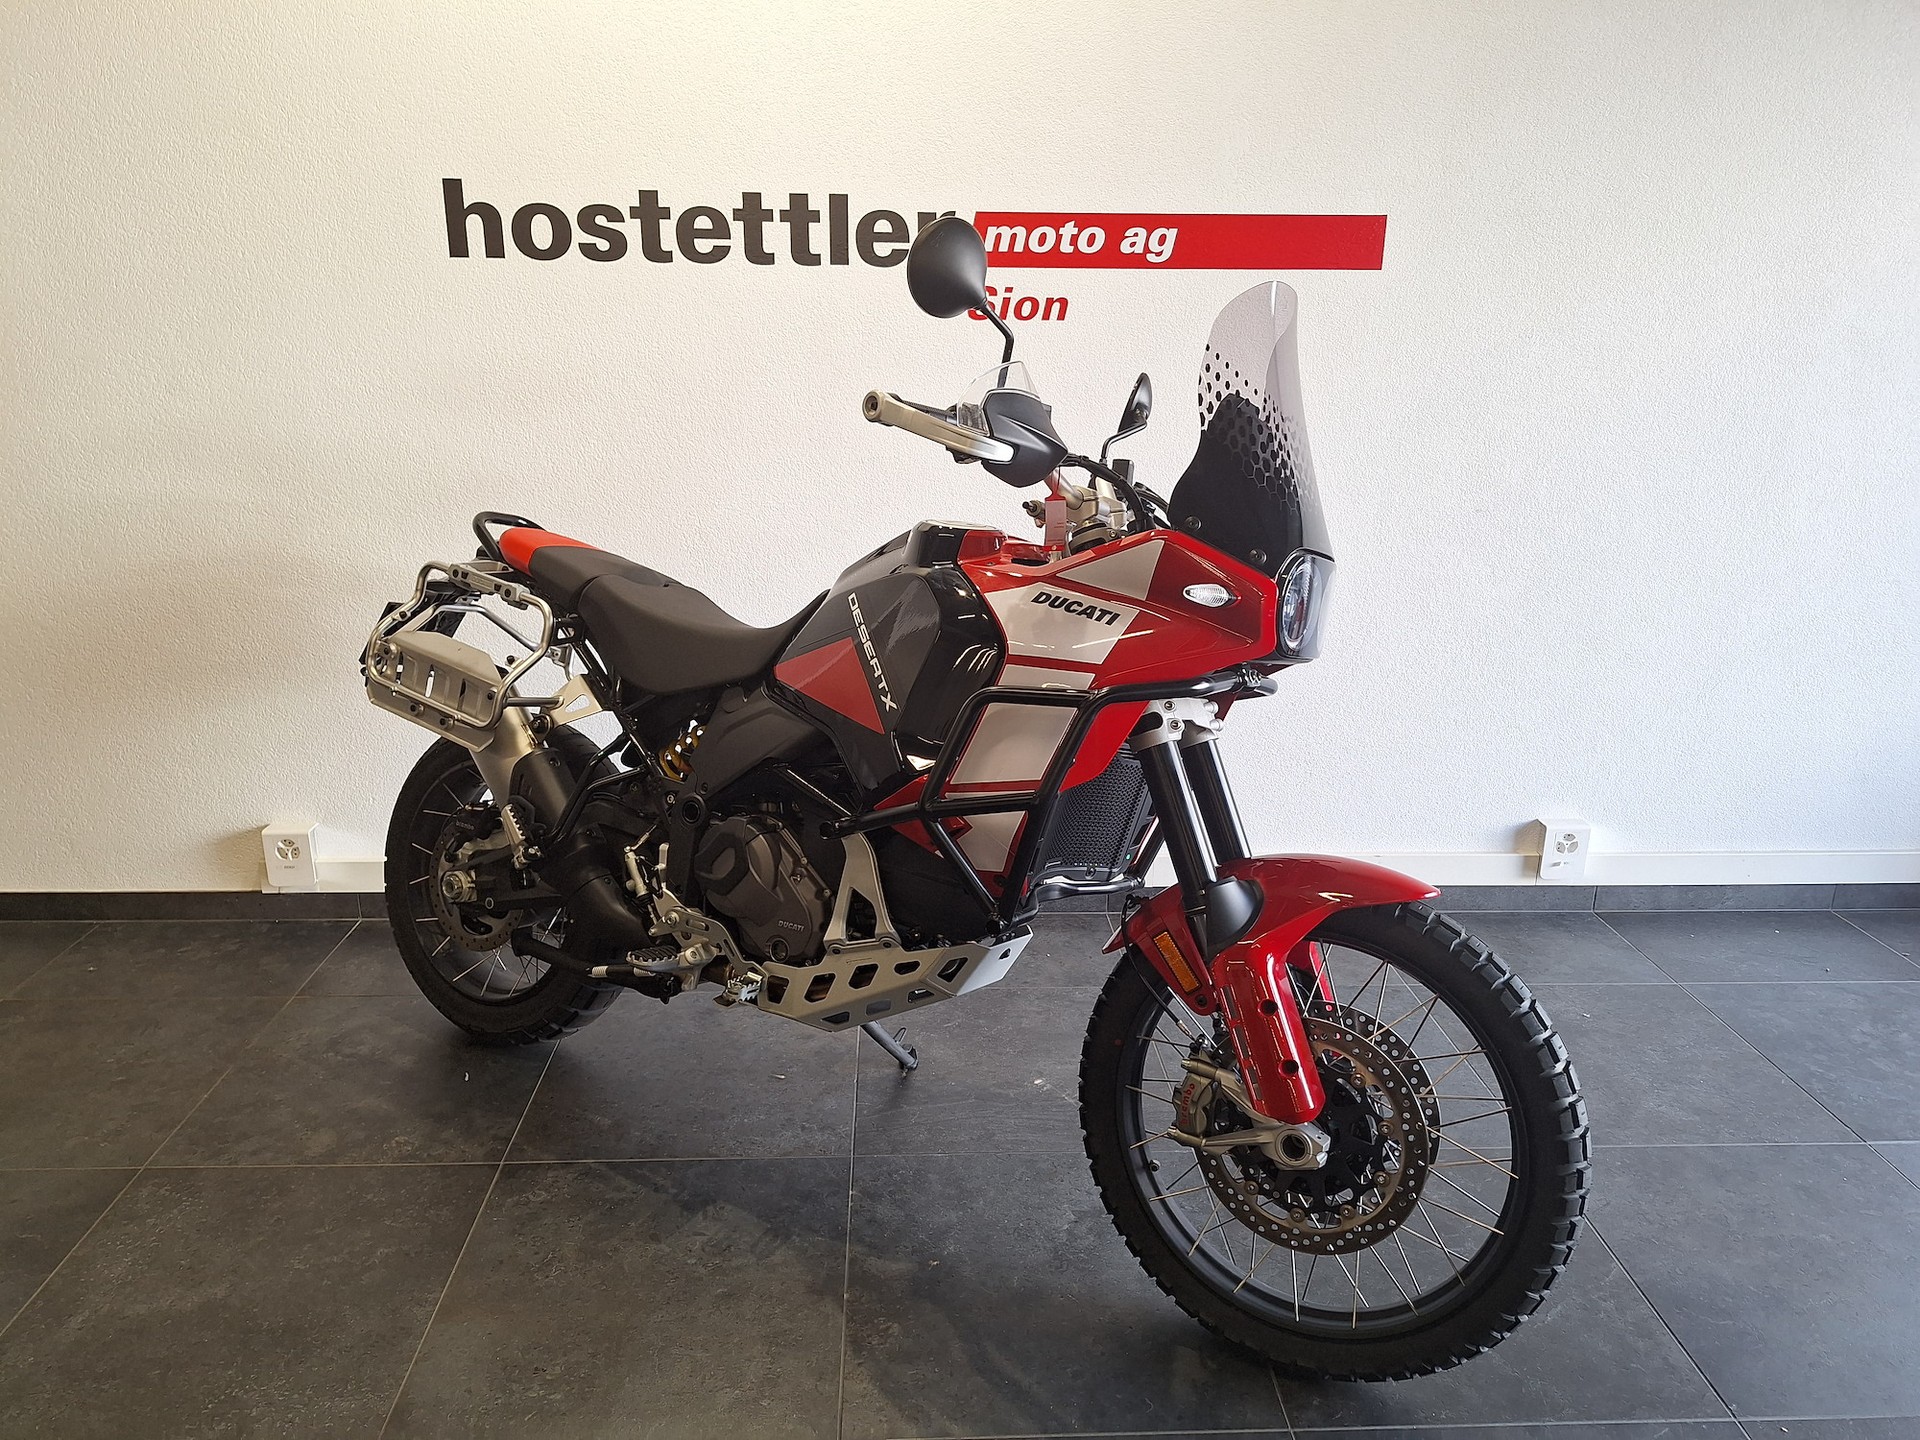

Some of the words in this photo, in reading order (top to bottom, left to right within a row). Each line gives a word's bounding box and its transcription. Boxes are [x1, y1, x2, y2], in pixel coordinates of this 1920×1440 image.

[985, 221, 1106, 254] moto
[1120, 226, 1179, 264] ag
[1031, 591, 1121, 626] DUCATI
[778, 920, 805, 931] DUCATI
